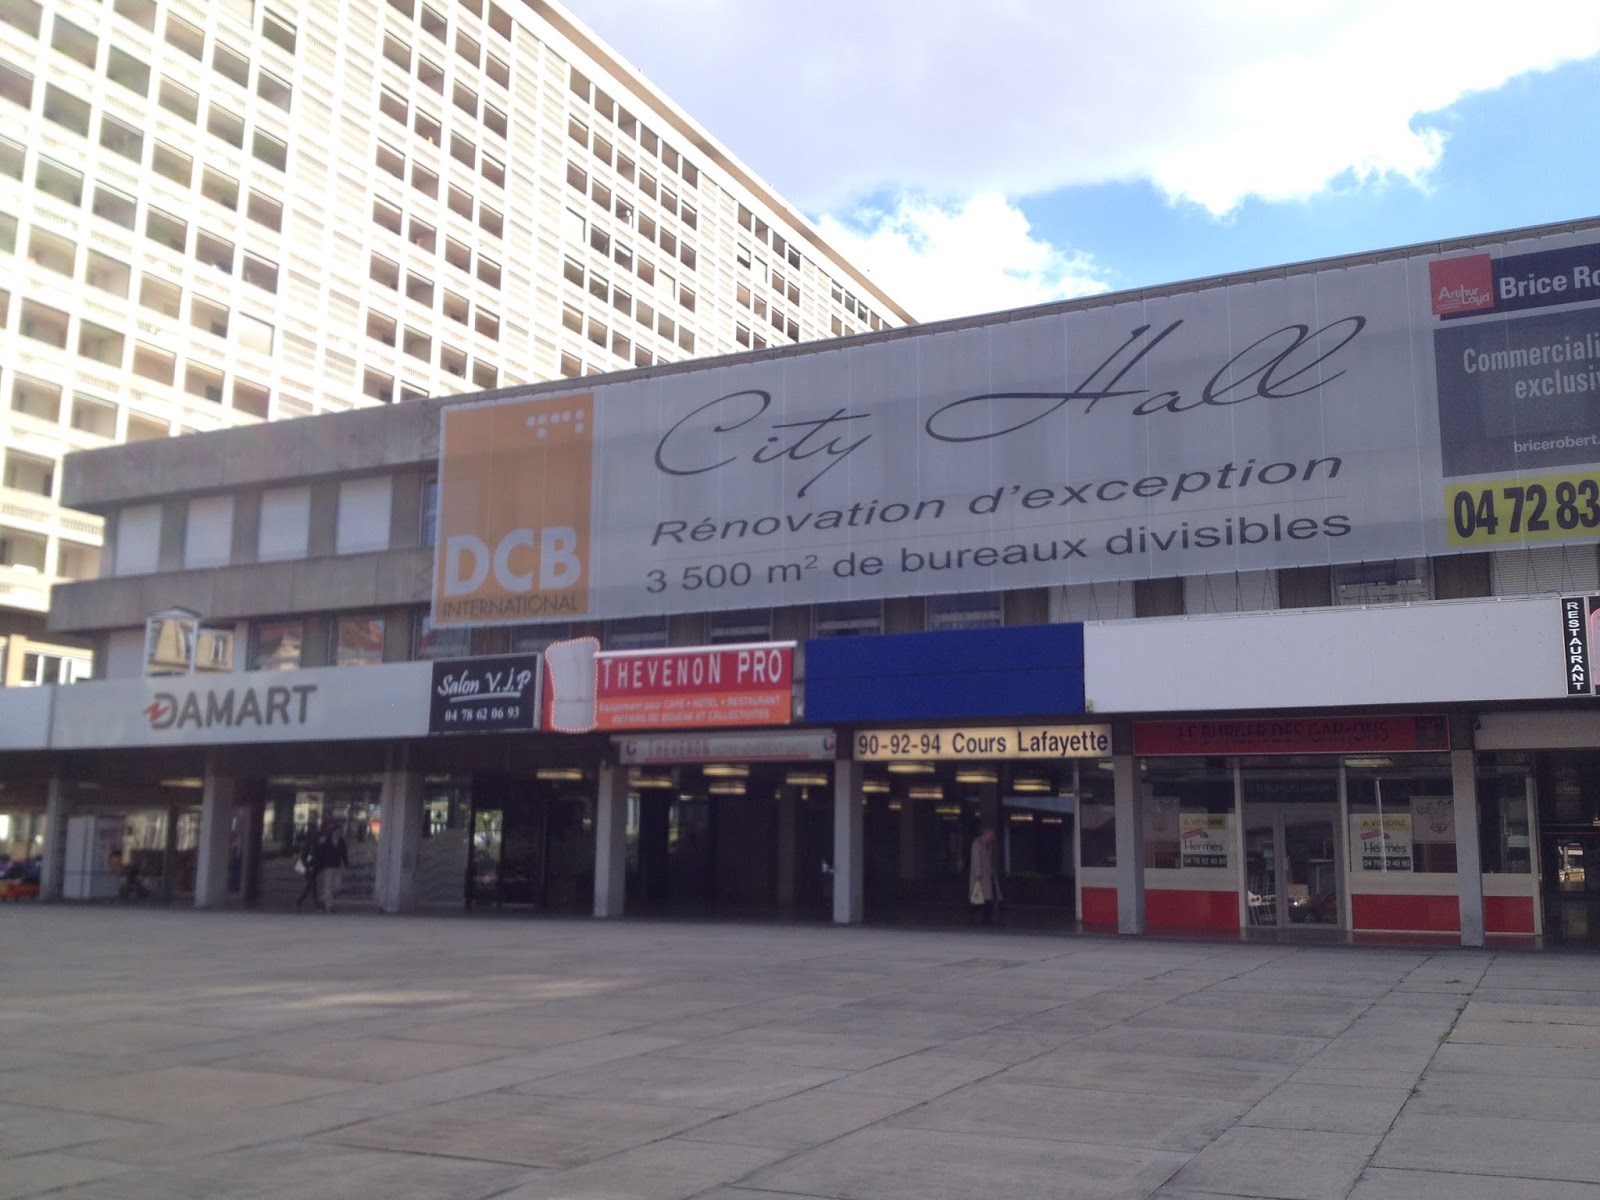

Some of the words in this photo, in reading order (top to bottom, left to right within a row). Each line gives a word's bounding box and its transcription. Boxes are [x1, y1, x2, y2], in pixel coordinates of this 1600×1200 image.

[1438, 284, 1479, 300] Arthur
[1462, 292, 1490, 305] Loyd
[1500, 273, 1567, 300] Brice
[655, 389, 872, 499] City
[925, 315, 1367, 442] Hall
[651, 499, 945, 546] Rénovation
[969, 455, 1342, 515] d'exception
[1454, 489, 1498, 538] 04
[1504, 484, 1549, 533] 72
[1555, 479, 1600, 530] 83
[444, 526, 582, 596] DCB
[646, 569, 667, 593] 3
[682, 561, 751, 591] 500
[833, 553, 884, 578] de
[901, 538, 1088, 573] bureaux
[1106, 513, 1352, 555] divisibles
[443, 594, 578, 617] INTERNATIONAL
[1566, 601, 1585, 691] RESTAURANT
[437, 669, 480, 696] Salon
[603, 653, 721, 689] THEVENON
[737, 649, 783, 684] PRO
[148, 684, 318, 730] DAMART
[859, 733, 941, 754] 90-92-94
[952, 732, 1006, 753] Cours
[1017, 730, 1108, 756] Lafayette
